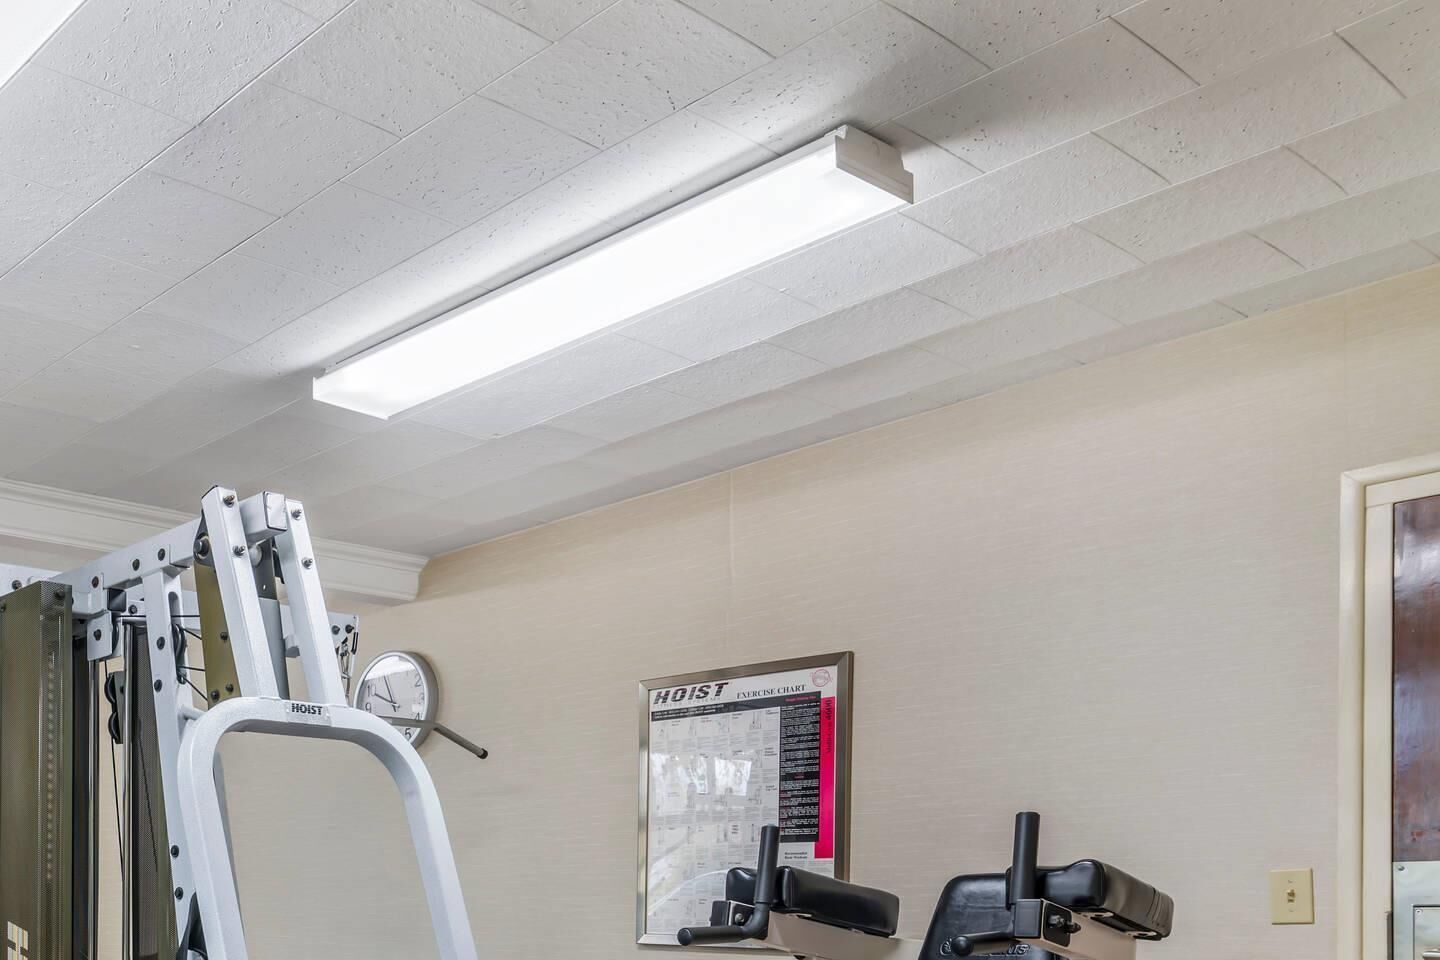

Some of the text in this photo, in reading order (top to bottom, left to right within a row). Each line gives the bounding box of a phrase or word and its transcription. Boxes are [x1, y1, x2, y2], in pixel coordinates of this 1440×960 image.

[367, 684, 376, 697] 10
[654, 682, 729, 704] HOIST
[736, 688, 776, 699] EXERCISE
[778, 684, 806, 694] CHART
[291, 703, 323, 715] HOIST
[404, 728, 412, 741] 5
